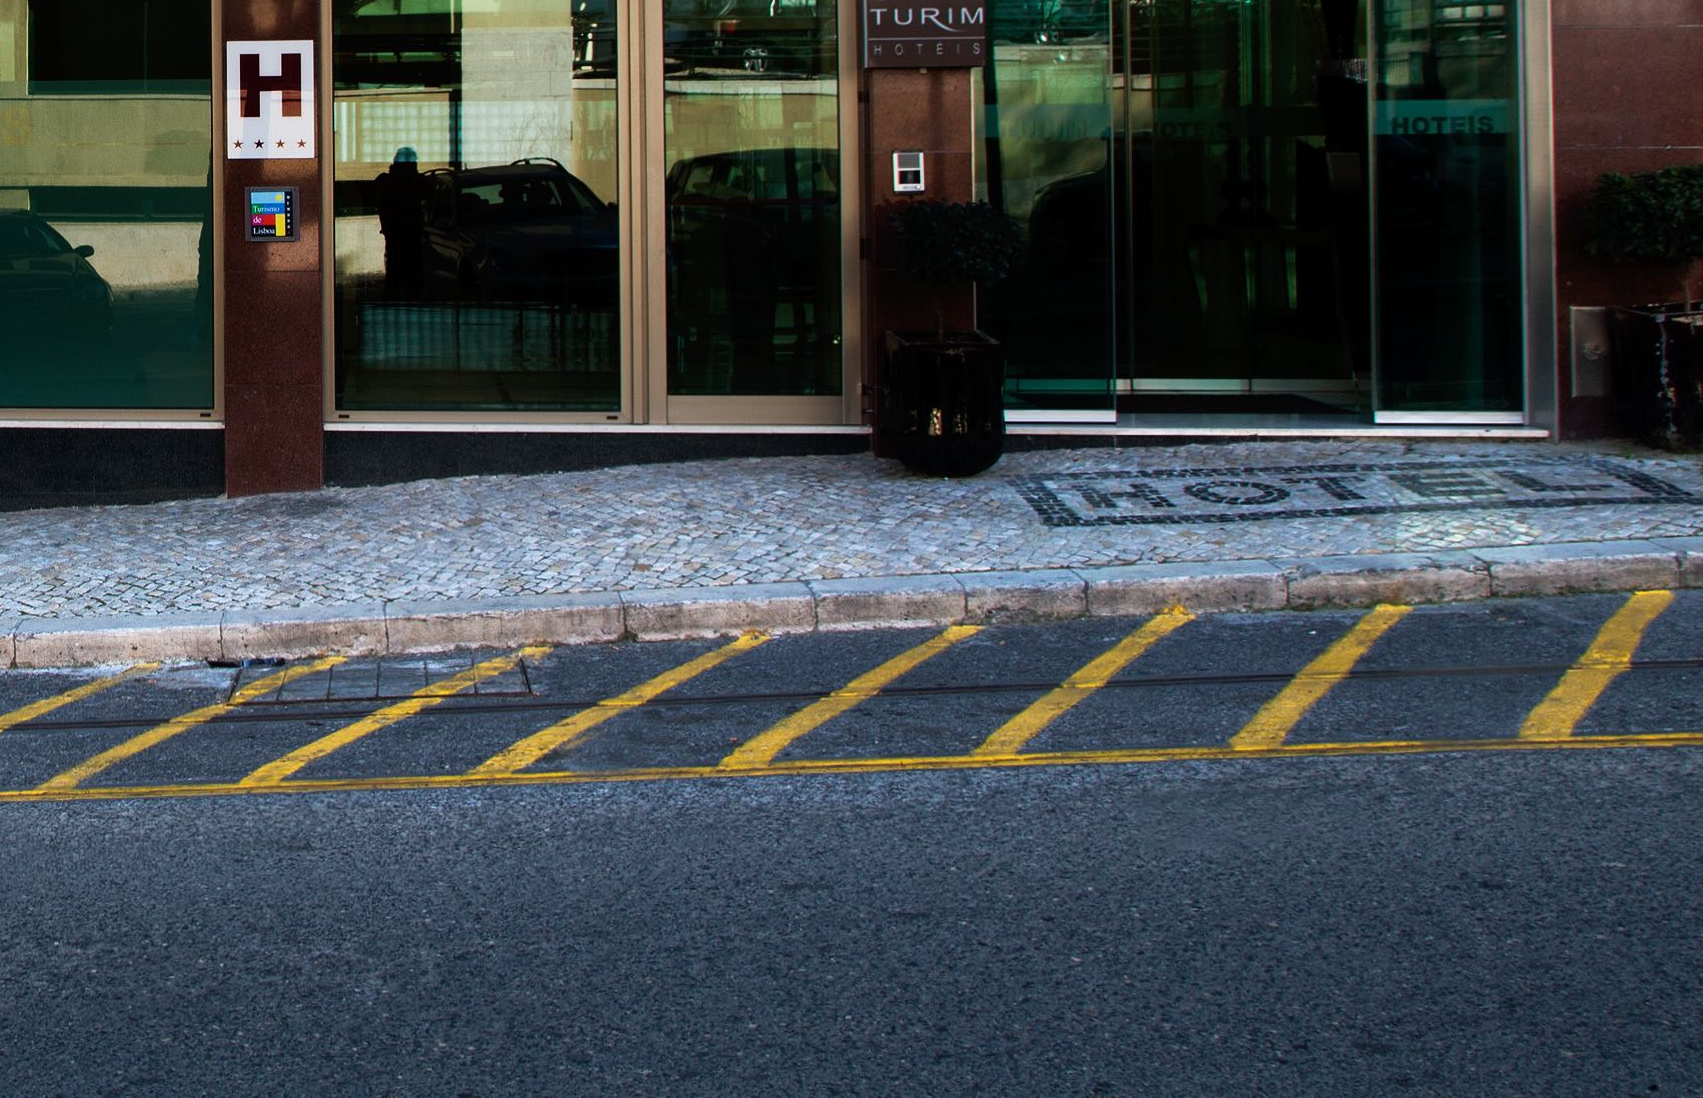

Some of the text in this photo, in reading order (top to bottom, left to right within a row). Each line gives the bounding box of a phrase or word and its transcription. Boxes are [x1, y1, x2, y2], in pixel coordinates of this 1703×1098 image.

[869, 7, 984, 32] TURIM
[873, 41, 981, 56] HOTÉIS
[239, 53, 302, 117] H
[1391, 115, 1494, 135] HOTEIS
[252, 205, 280, 213] Turismo
[1078, 470, 1614, 509] HOTEL
